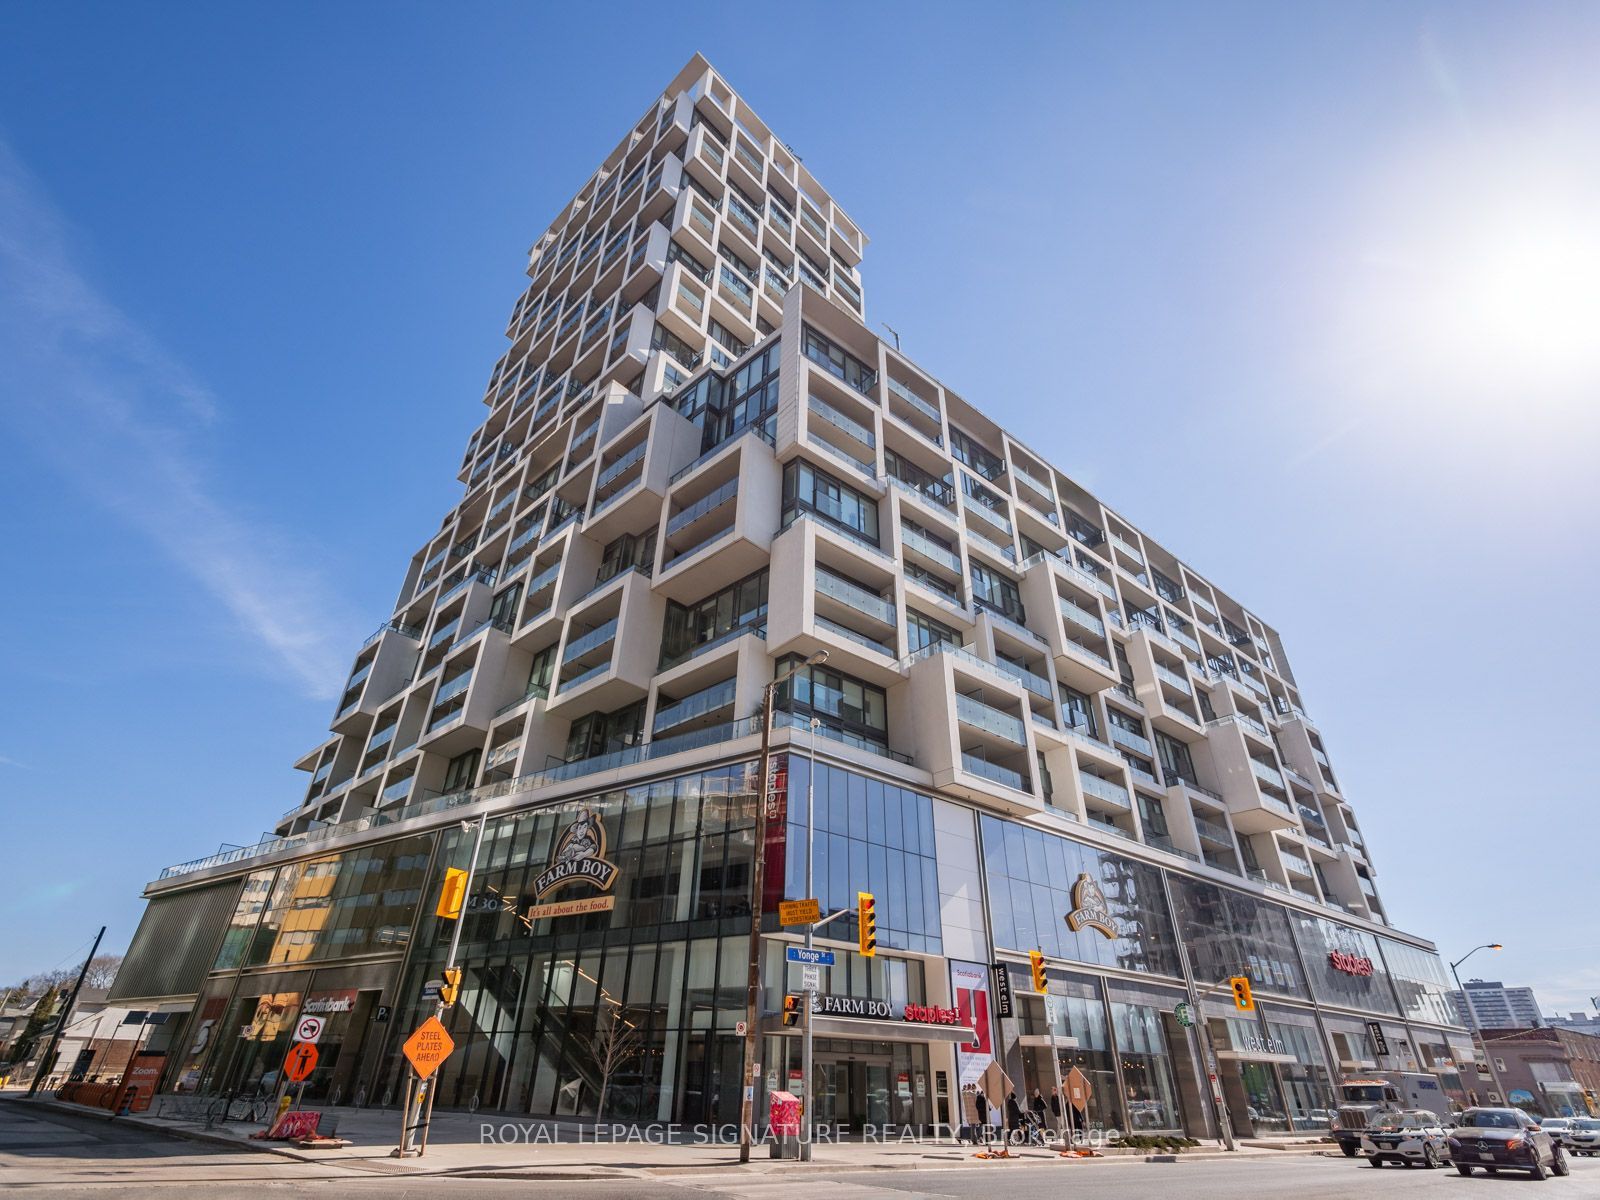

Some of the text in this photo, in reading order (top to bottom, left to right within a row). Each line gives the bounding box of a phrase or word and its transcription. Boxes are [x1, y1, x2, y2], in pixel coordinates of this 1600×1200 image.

[767, 762, 777, 810] staples
[537, 859, 611, 892] FARM BOY
[530, 899, 609, 917] It's all about the food.
[1075, 910, 1117, 931] FARM BOY
[797, 949, 820, 962] Yonge
[957, 969, 982, 979] Scotiabank
[998, 968, 1006, 992] west
[303, 996, 349, 1013] Scotiabank
[377, 1007, 386, 1020] P
[824, 996, 893, 1017] FARM BOY
[904, 1002, 956, 1024] staples
[421, 1031, 441, 1040] STEEL
[1243, 1034, 1285, 1054] west elm
[416, 1042, 442, 1051] PLATES
[416, 1053, 440, 1061] AHEAD
